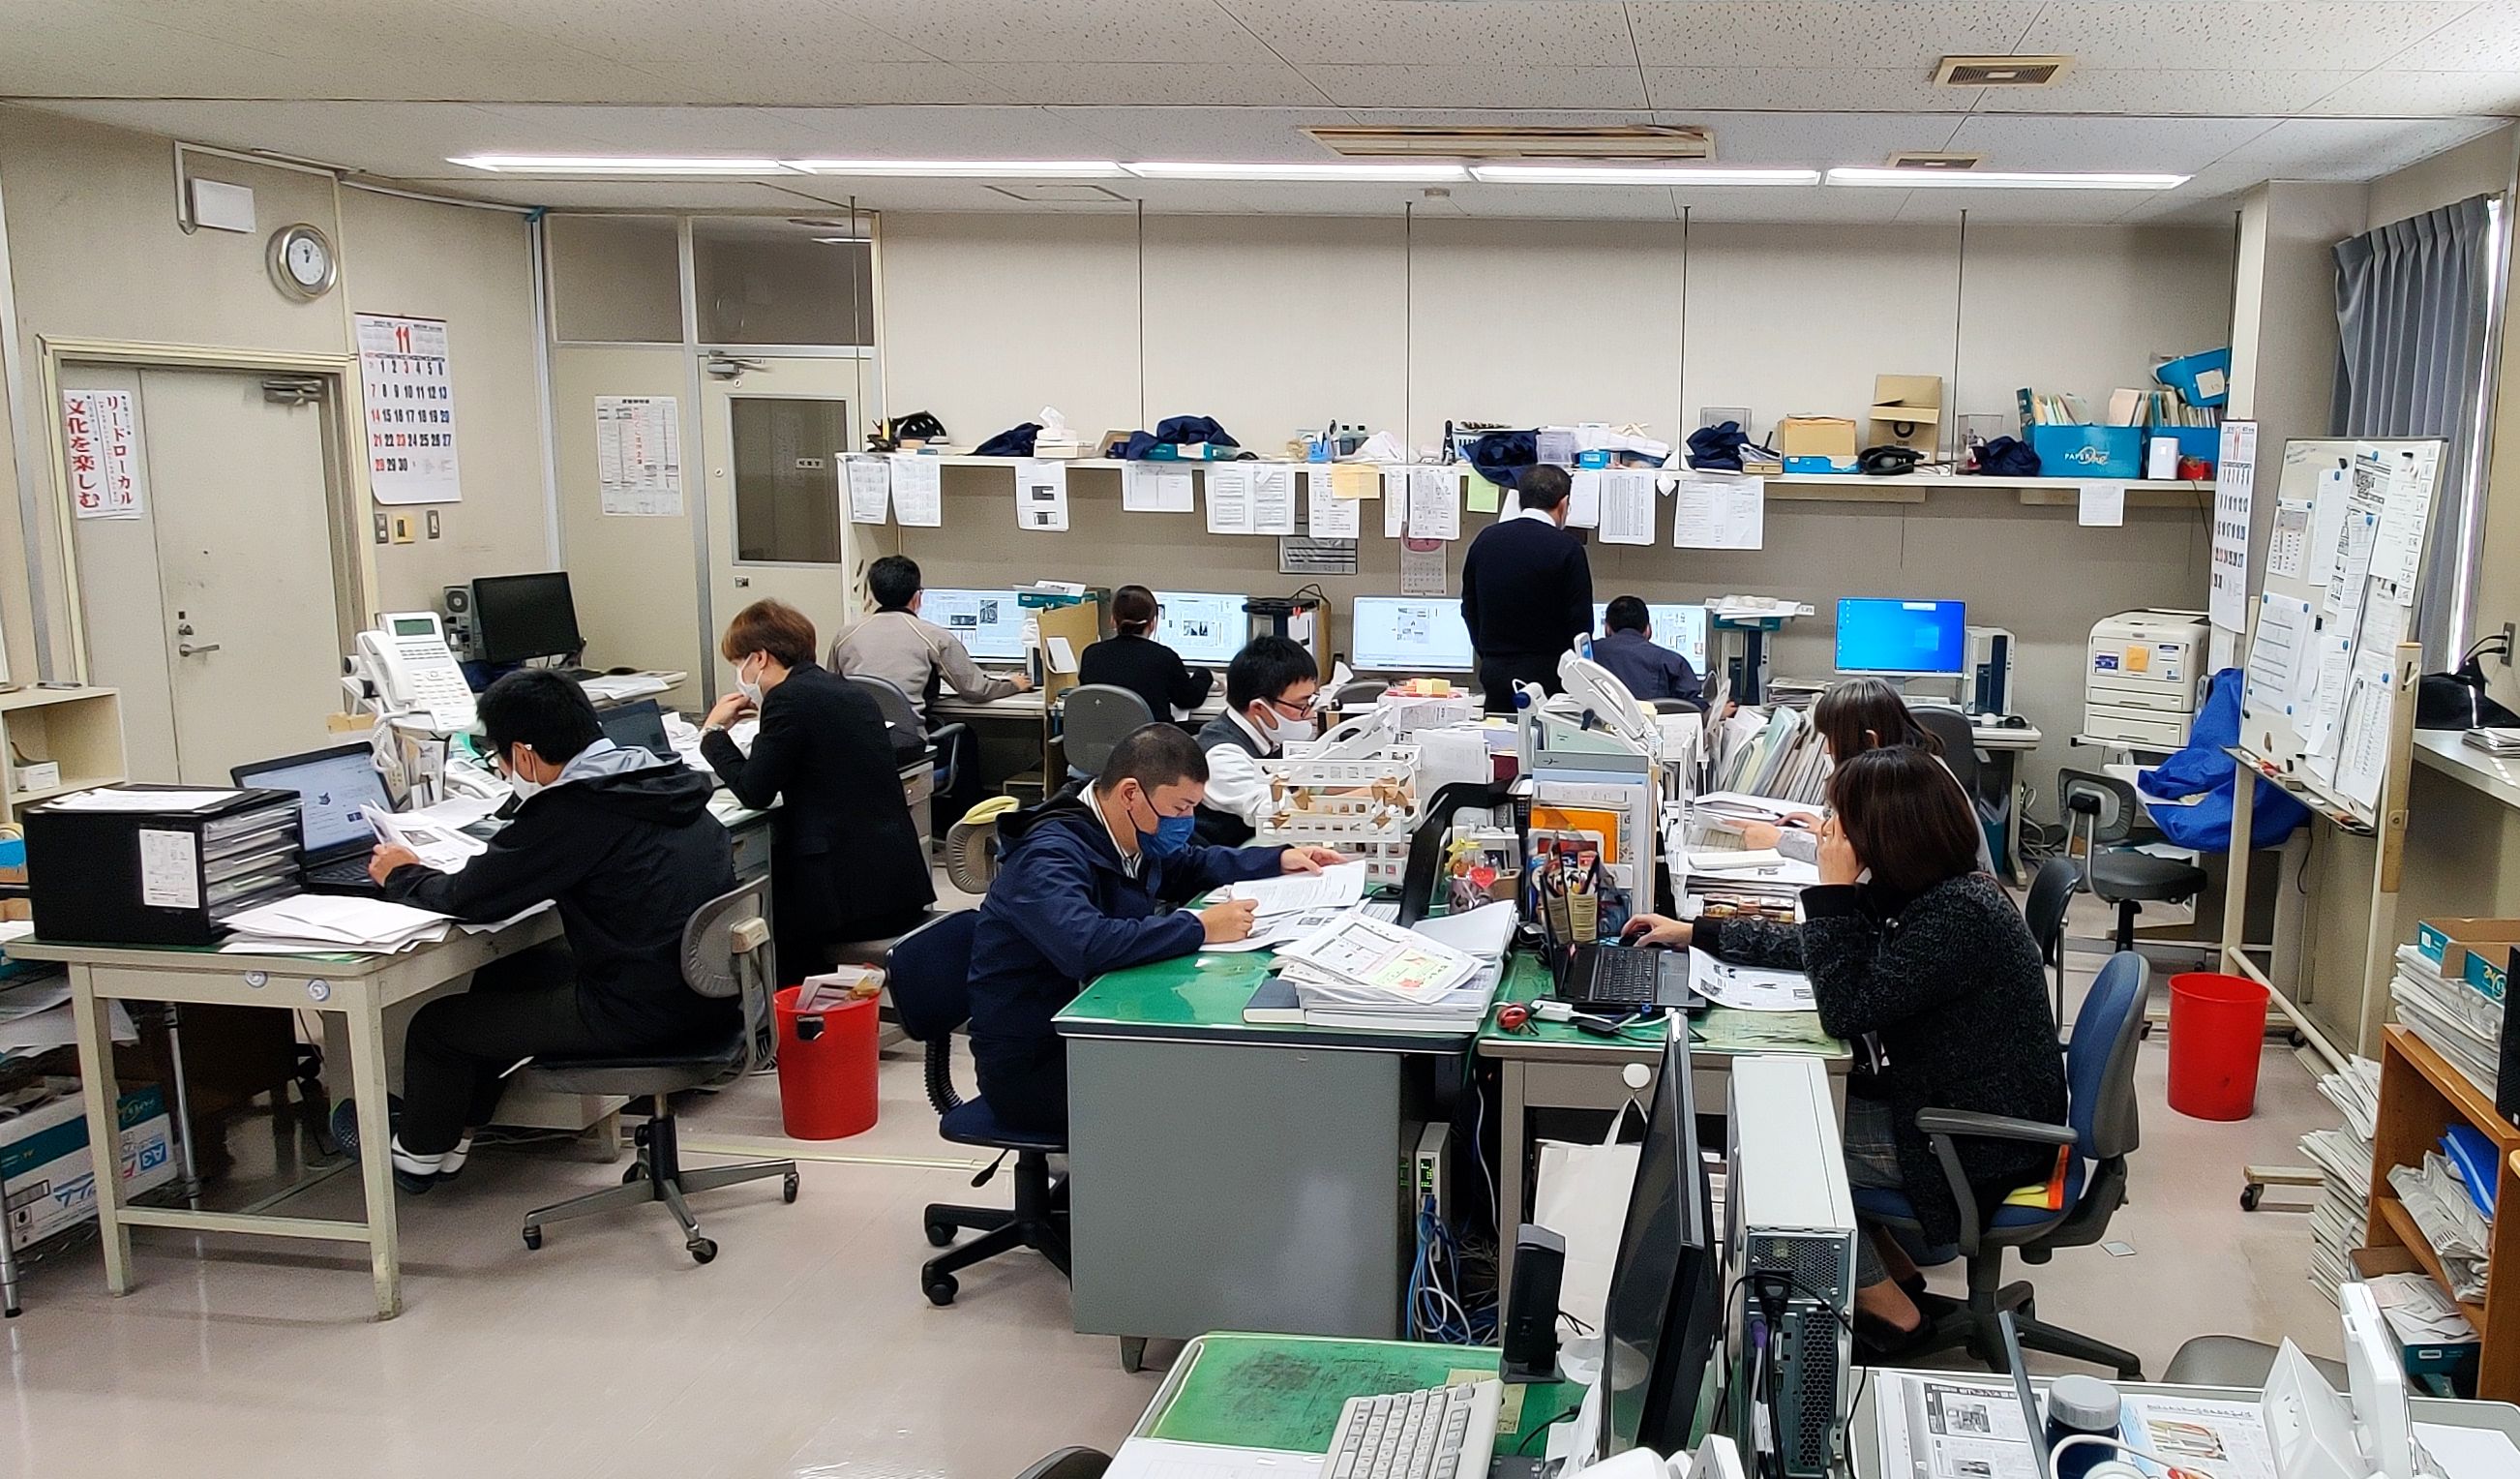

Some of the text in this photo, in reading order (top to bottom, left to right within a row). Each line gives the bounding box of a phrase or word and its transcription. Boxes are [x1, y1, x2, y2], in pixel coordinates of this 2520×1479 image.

[395, 325, 411, 354] 11
[66, 398, 101, 508] 文化を楽しむ
[106, 395, 134, 505] リードローカル
